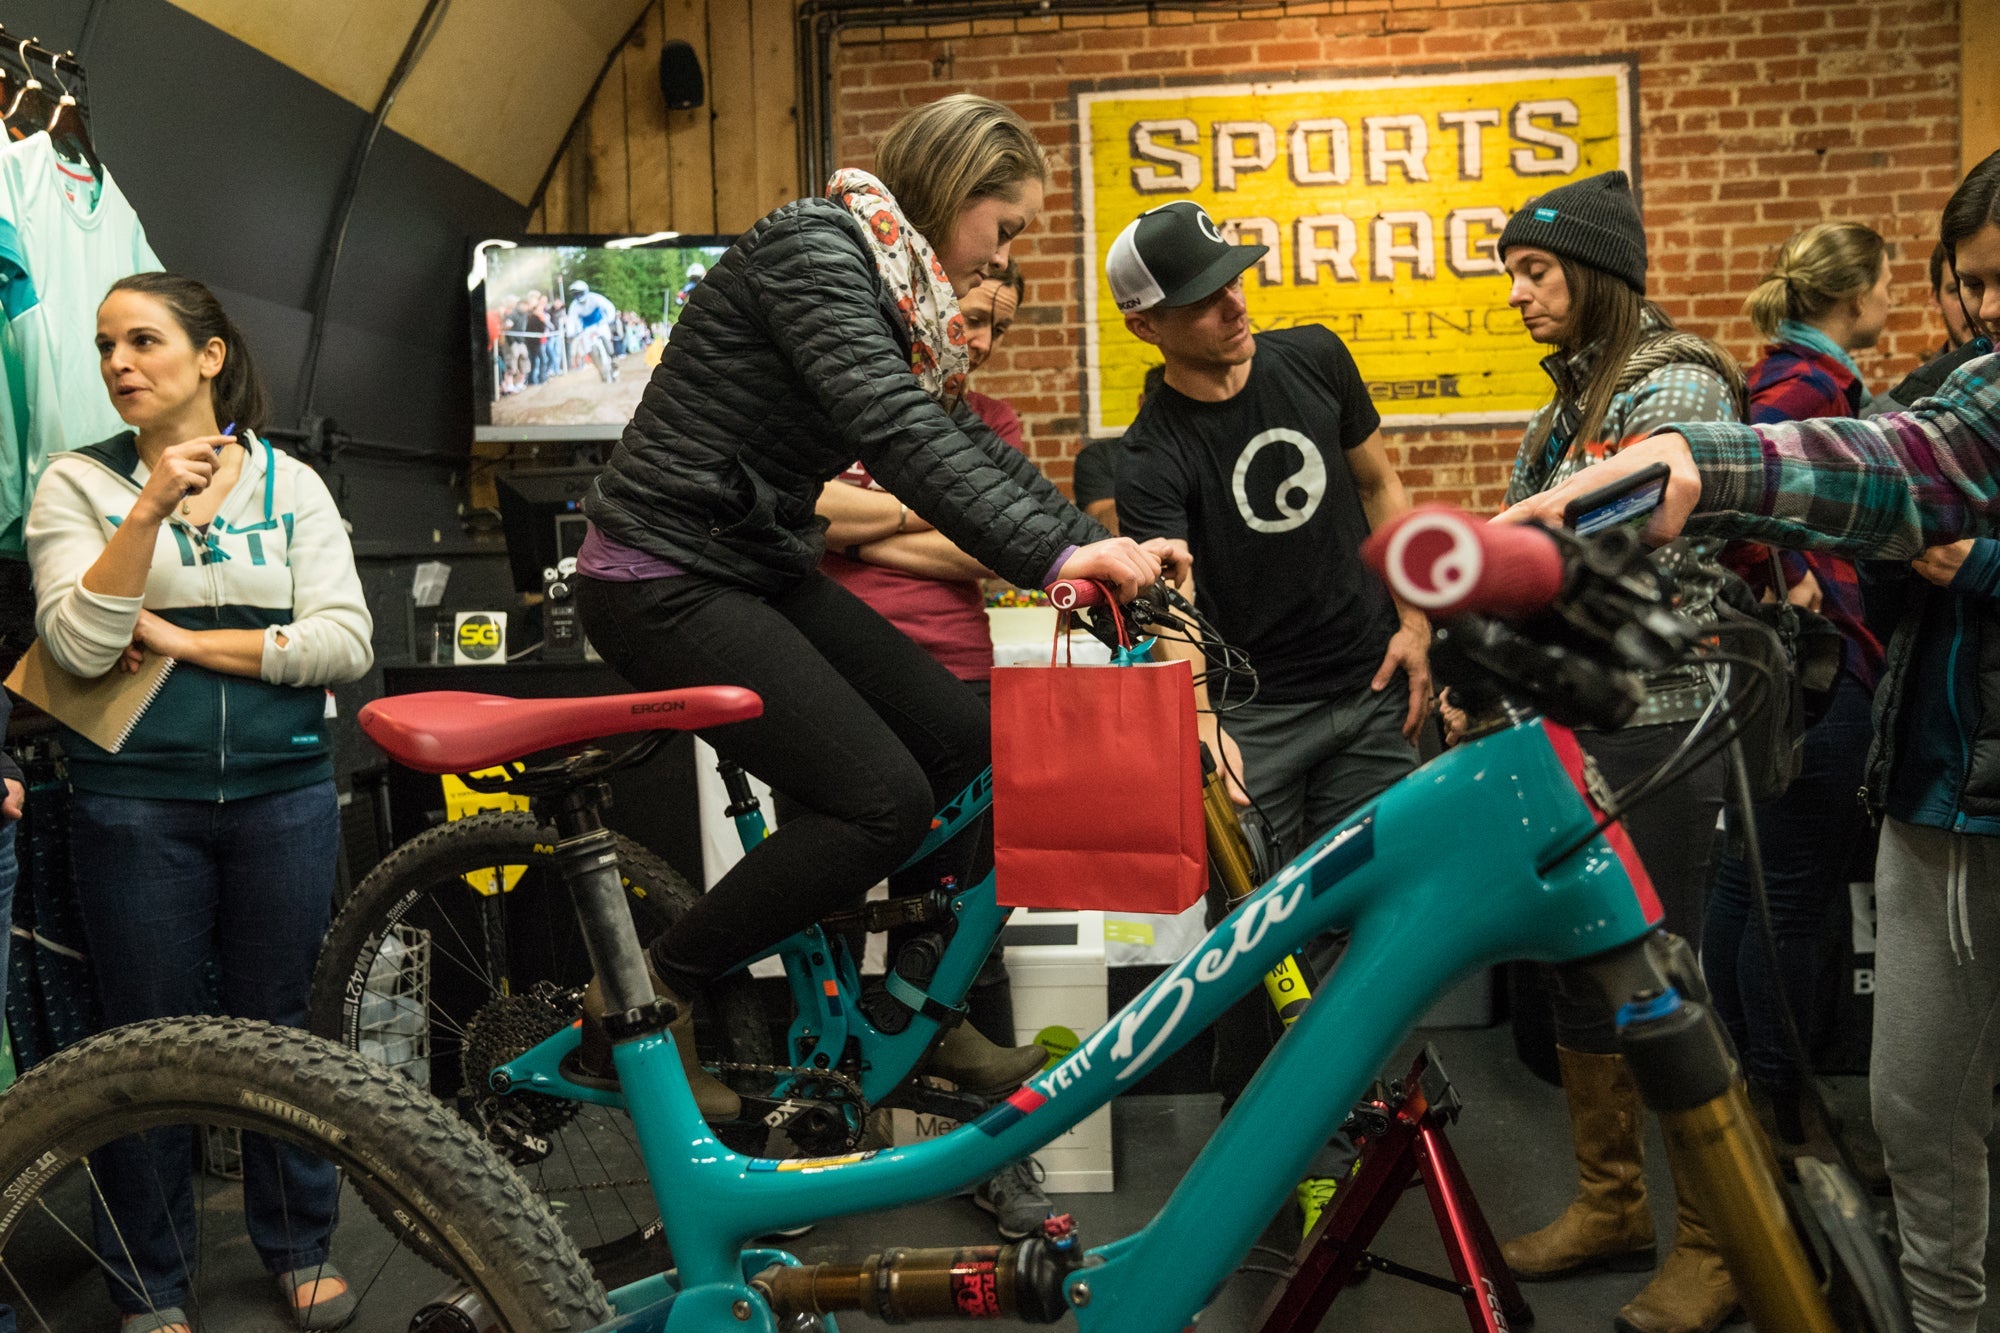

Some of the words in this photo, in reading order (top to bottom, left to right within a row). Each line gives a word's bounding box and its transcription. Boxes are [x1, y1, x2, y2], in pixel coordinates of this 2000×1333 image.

[1129, 98, 1580, 195] SPORTS
[1219, 206, 1509, 287] ARAG
[460, 623, 499, 646] SG
[631, 700, 686, 714] ERGON
[344, 931, 382, 1005] XM421
[1084, 817, 1372, 1080] Beta
[1039, 1048, 1092, 1098] YETI
[3, 1167, 38, 1200] SWISS
[36, 1150, 57, 1170] DT
[1480, 1276, 1510, 1333] FEE
